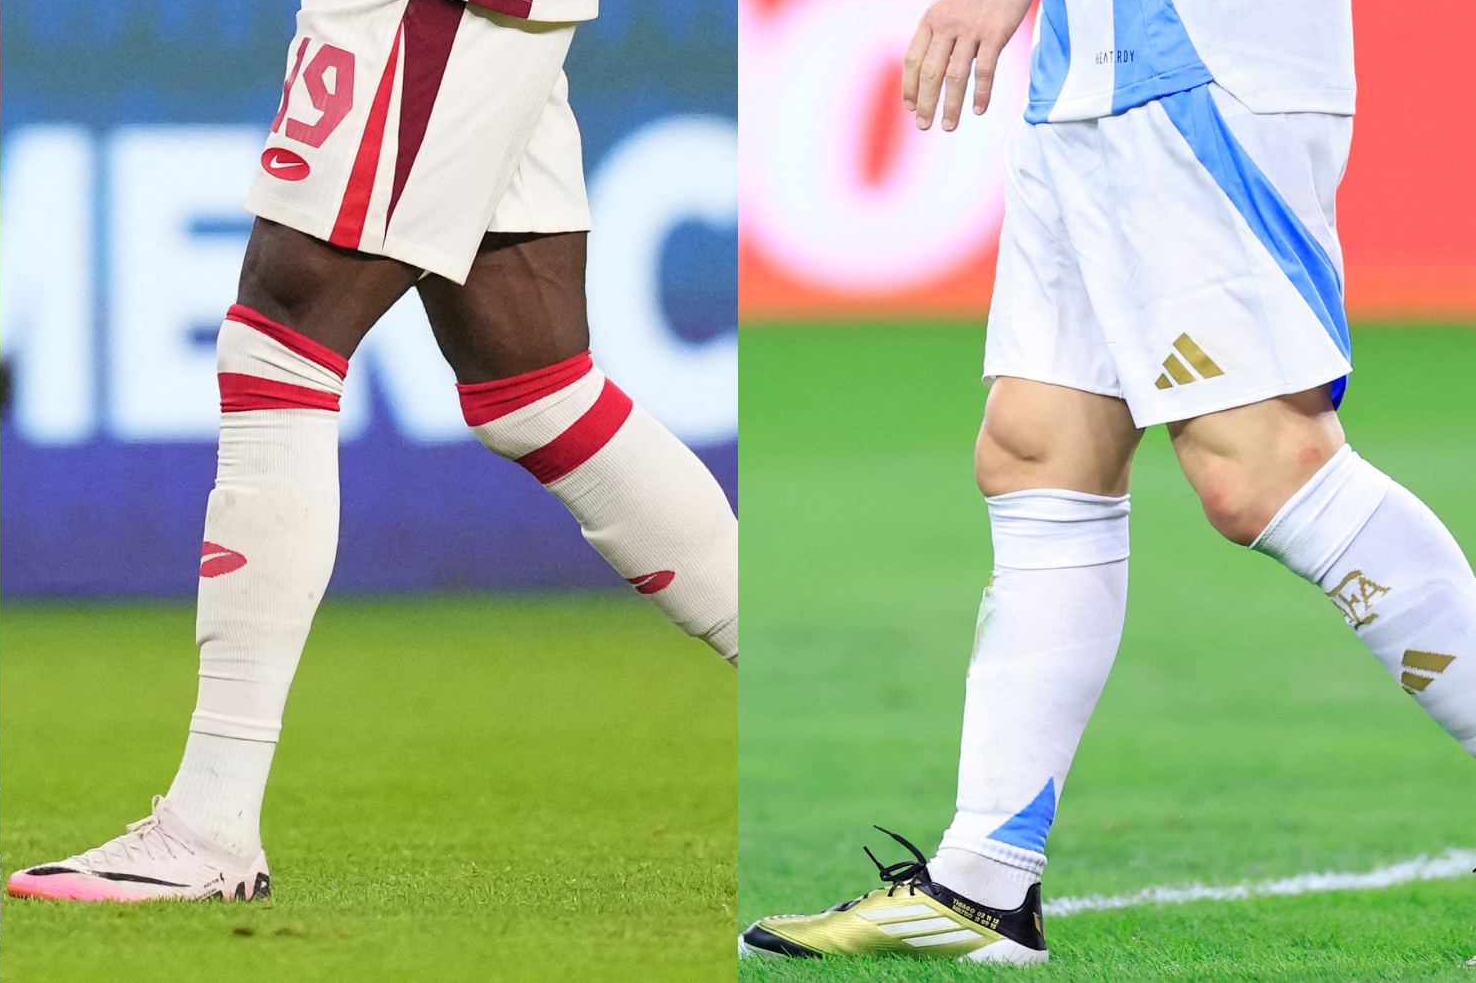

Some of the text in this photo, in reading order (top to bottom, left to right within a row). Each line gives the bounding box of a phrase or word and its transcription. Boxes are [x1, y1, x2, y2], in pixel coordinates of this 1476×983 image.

[269, 37, 356, 149] 19
[952, 905, 973, 918] MATEO
[953, 898, 975, 913] THIAGO
